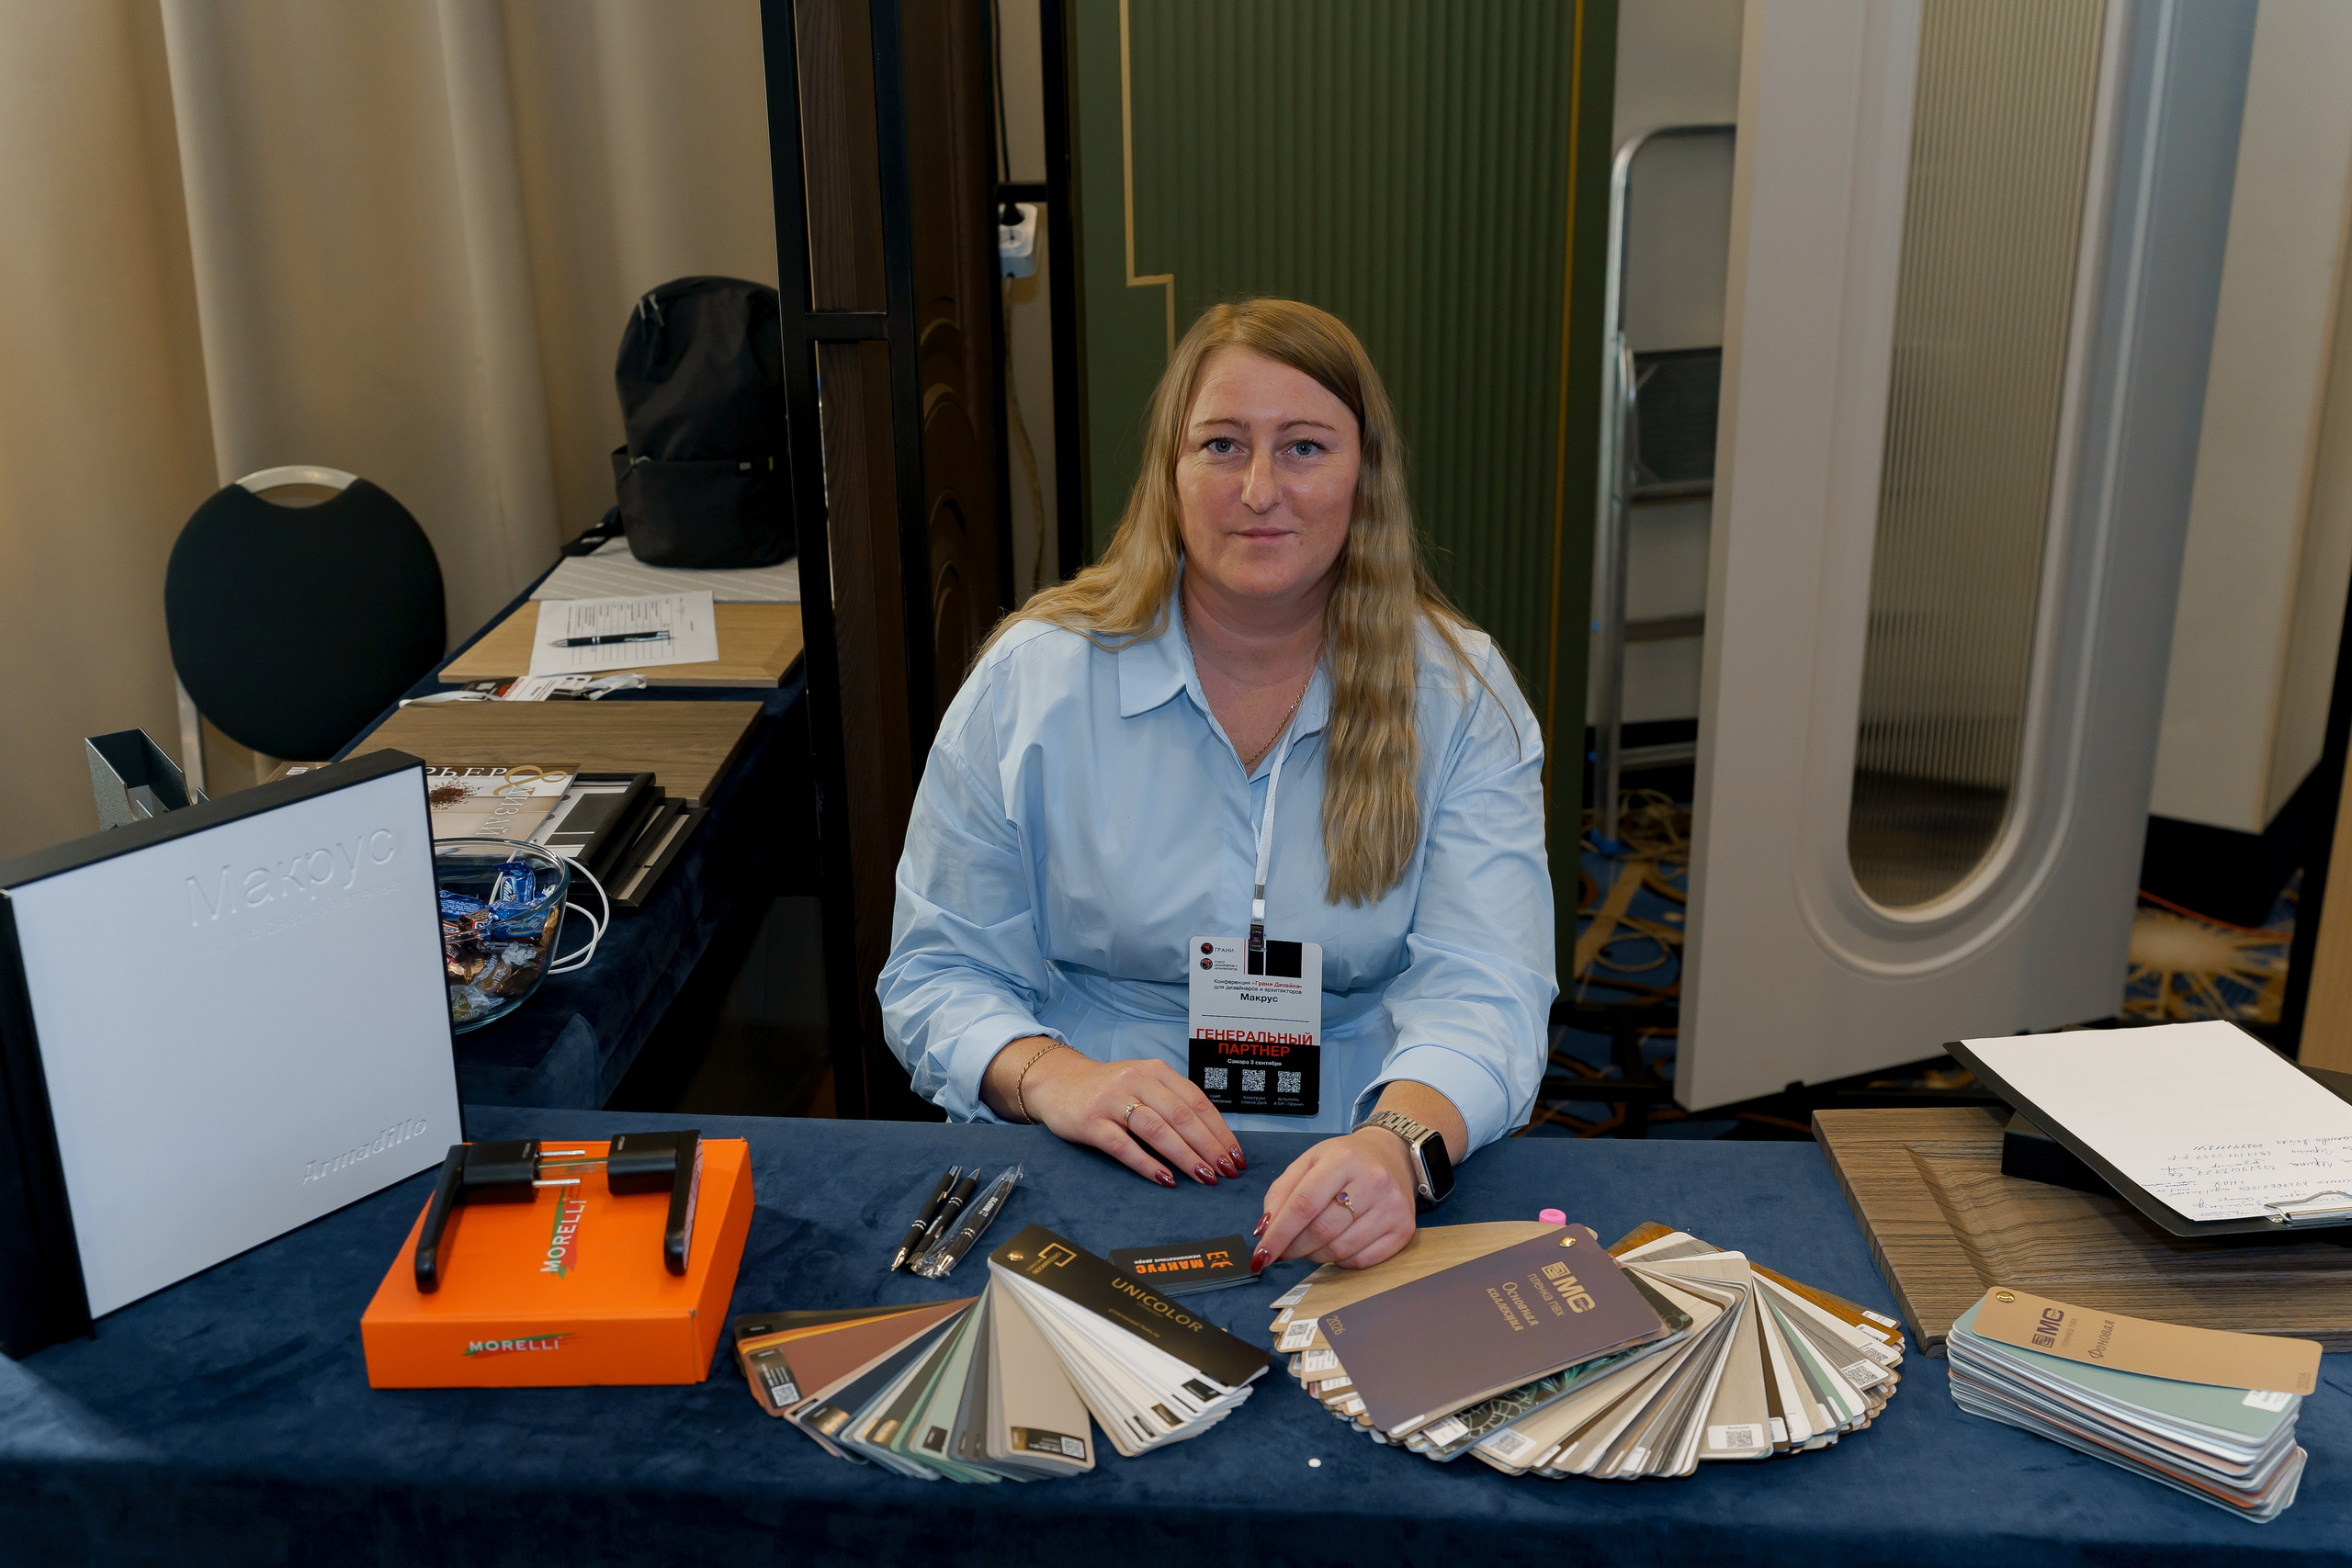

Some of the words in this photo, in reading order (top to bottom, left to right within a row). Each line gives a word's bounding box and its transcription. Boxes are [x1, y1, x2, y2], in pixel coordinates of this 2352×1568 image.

[186, 829, 394, 927] Макрус
[1240, 993, 1278, 1003] Макрус
[1273, 981, 1303, 989] Дизайна»
[1196, 1028, 1313, 1045] ГЕНЕРАЛЬНЫЙ
[1218, 1043, 1290, 1056] ПАРТНЕР
[302, 1117, 428, 1185] Armadillo
[540, 1200, 587, 1272] MORELLI
[1111, 1277, 1204, 1333] UNICOLOR
[1486, 1288, 1524, 1332] коллекция
[1502, 1281, 1539, 1326] Основная
[469, 1340, 559, 1351] MORELLI
[1326, 1315, 1347, 1336] 2026
[2088, 1319, 2115, 1359] Фоновая
